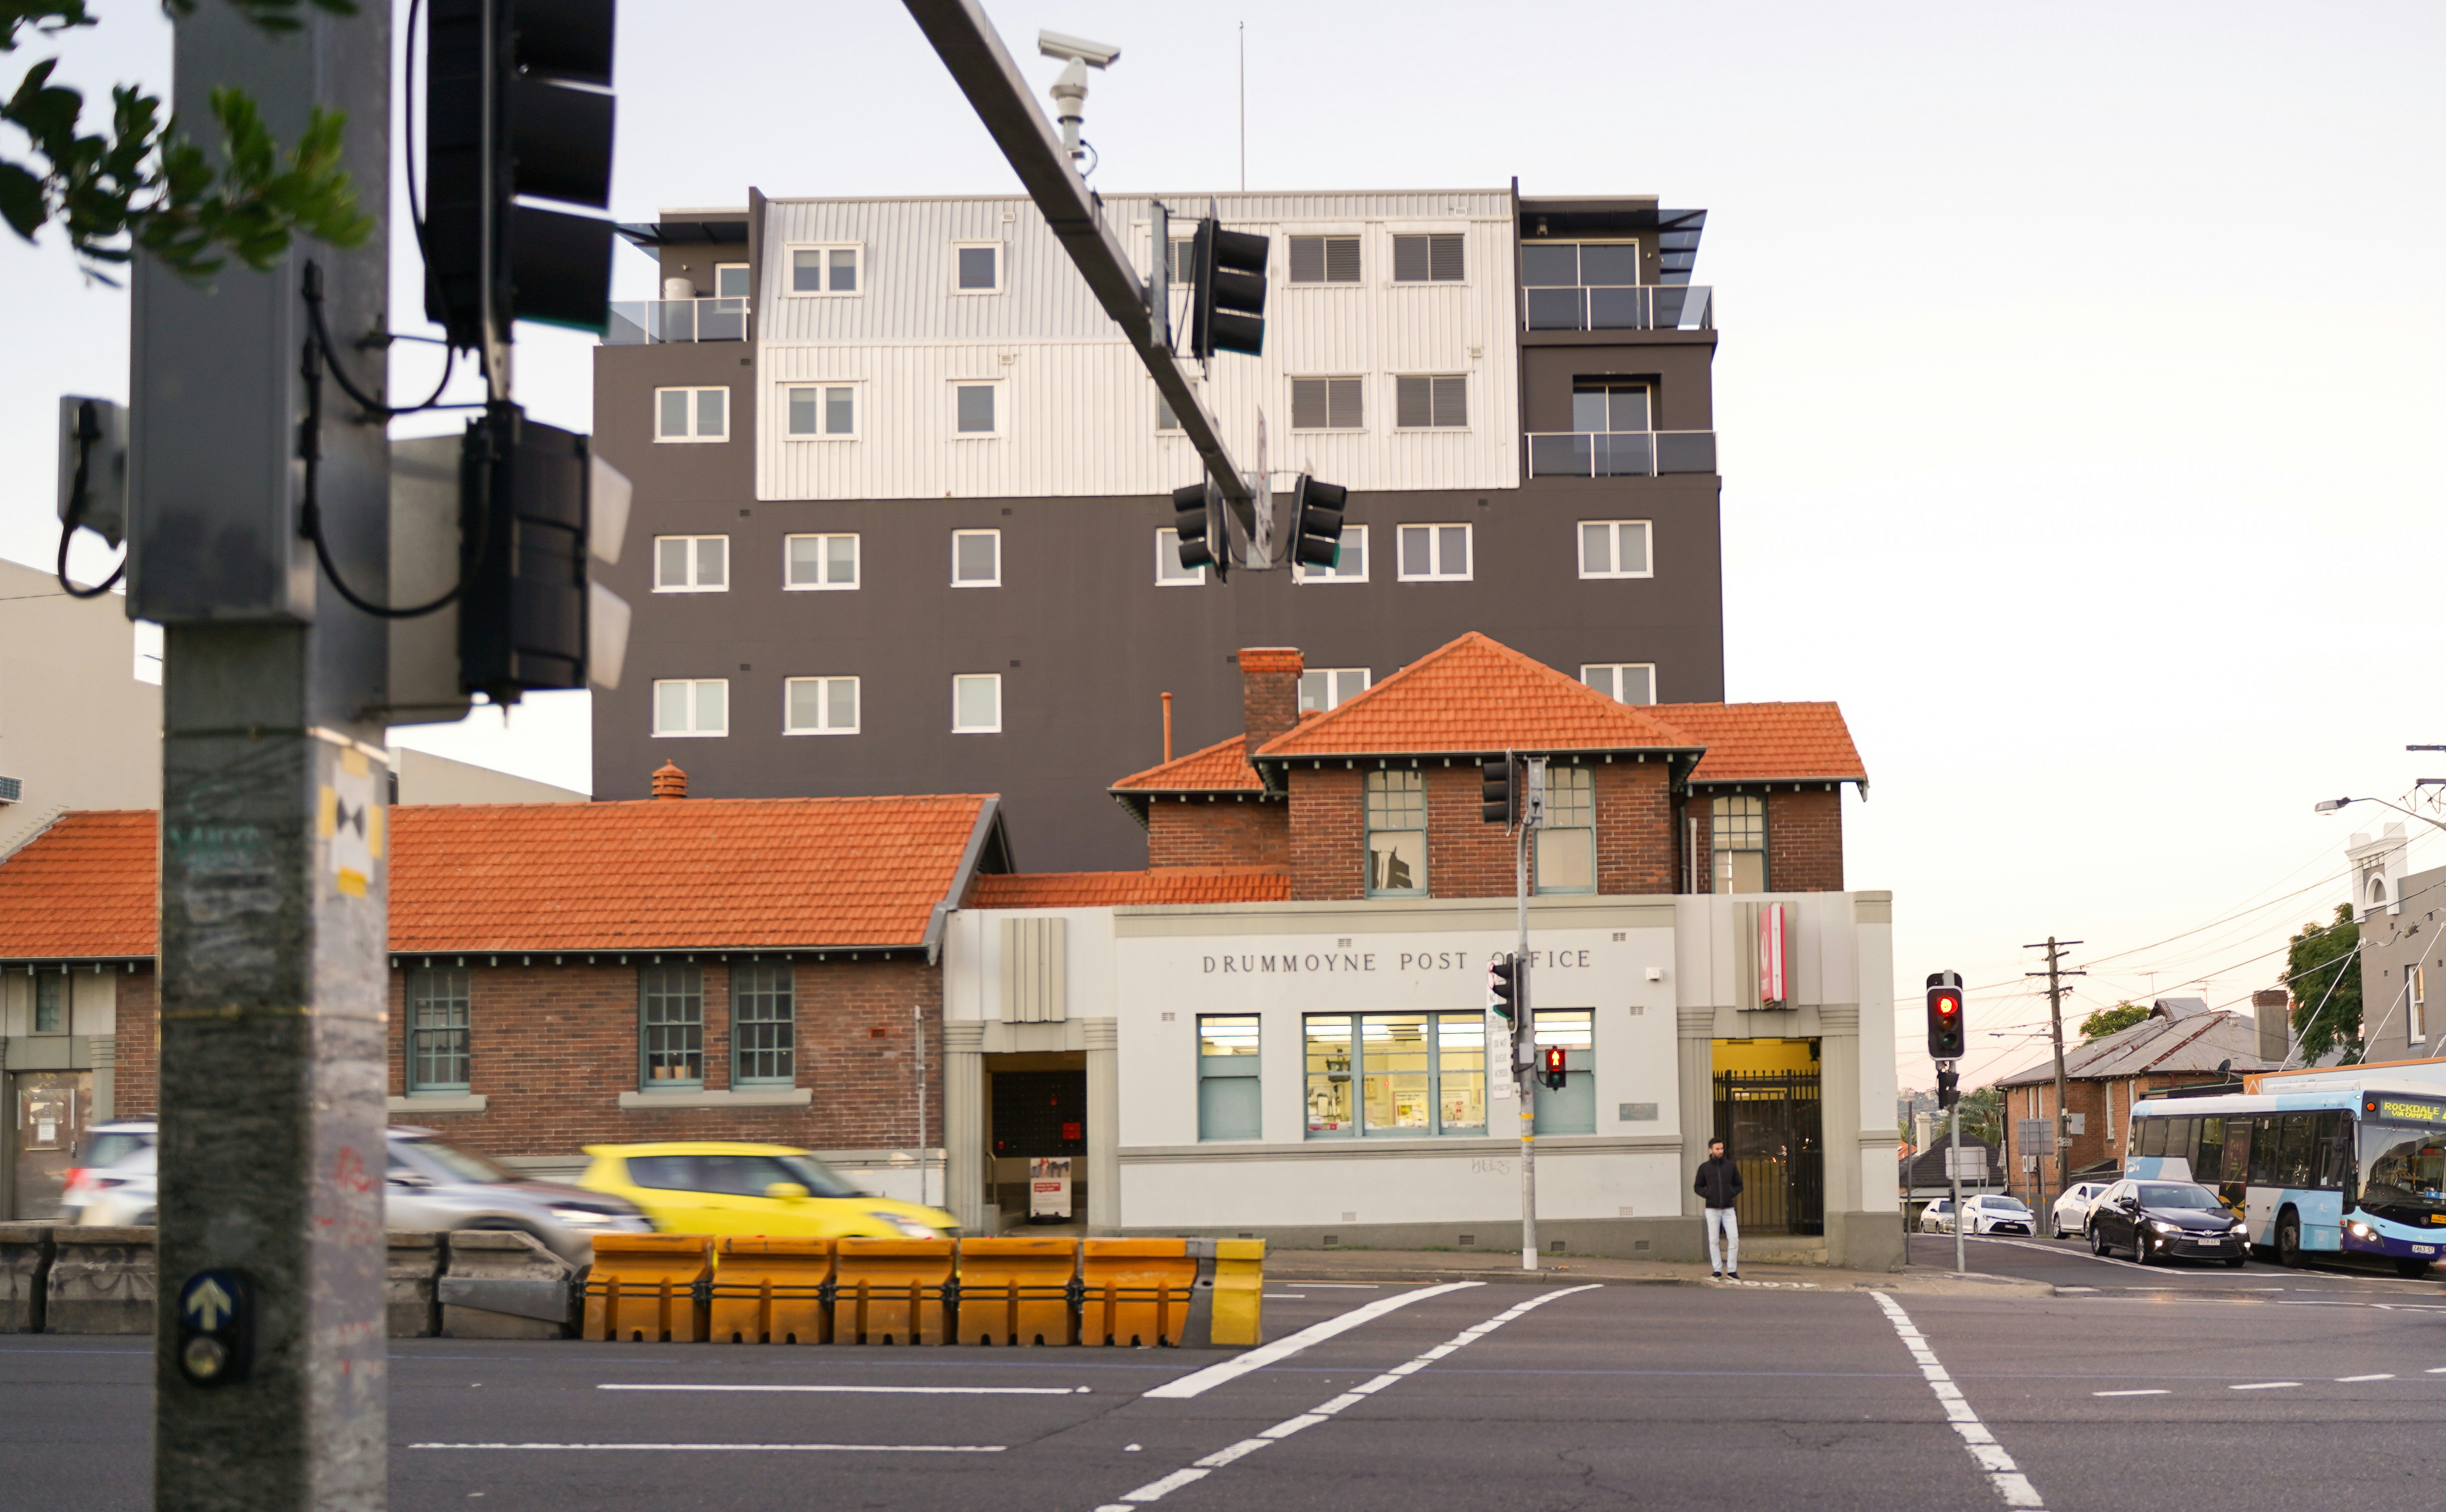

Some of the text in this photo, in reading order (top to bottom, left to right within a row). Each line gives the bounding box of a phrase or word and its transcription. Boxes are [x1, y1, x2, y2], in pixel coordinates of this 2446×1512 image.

[1203, 950, 1590, 973] DRUMMOYNE POST OFICE
[2384, 1101, 2440, 1115] ROCKDALE
[2391, 1109, 2404, 1117] VIA
[2405, 1111, 2433, 1120] CAMPSIE
